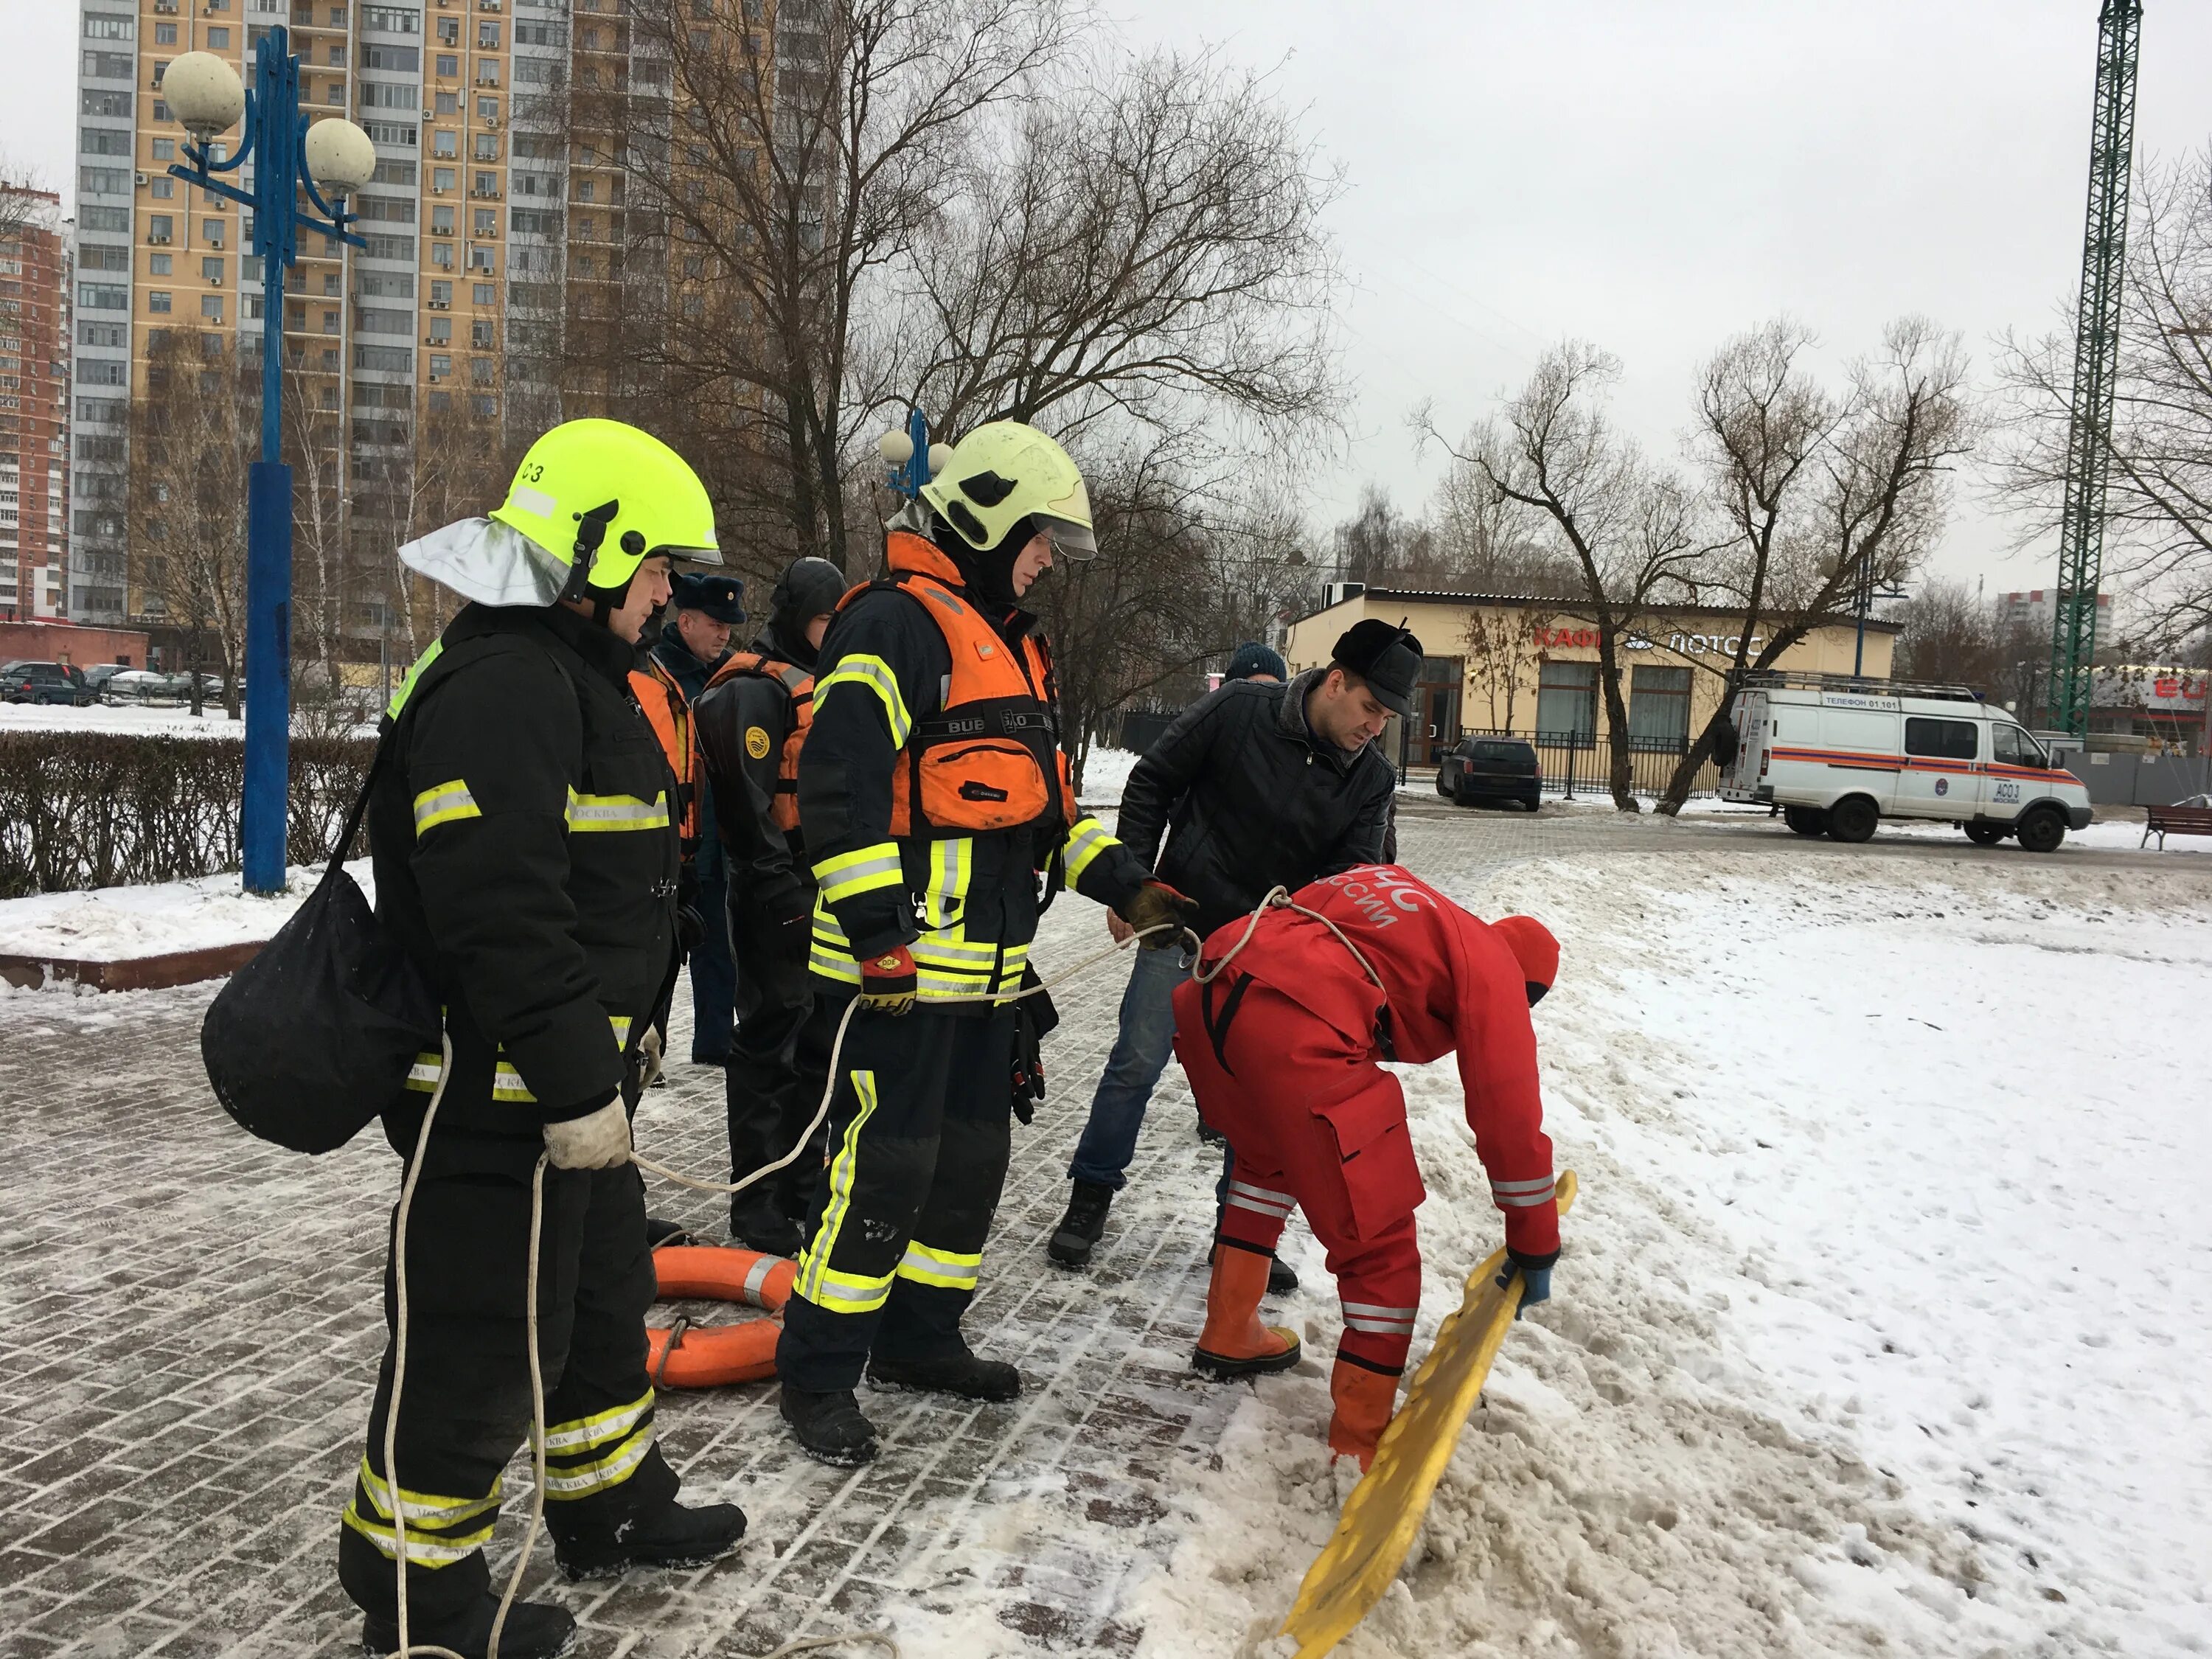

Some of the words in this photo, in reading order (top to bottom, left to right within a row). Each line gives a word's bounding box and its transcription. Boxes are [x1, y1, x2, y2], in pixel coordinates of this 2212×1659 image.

[1666, 634, 1763, 656] ЛОТОС
[1826, 697, 1867, 706] ТЕЛЕФОН
[1995, 783, 2014, 798] АСО
[2014, 785, 2020, 799] 3
